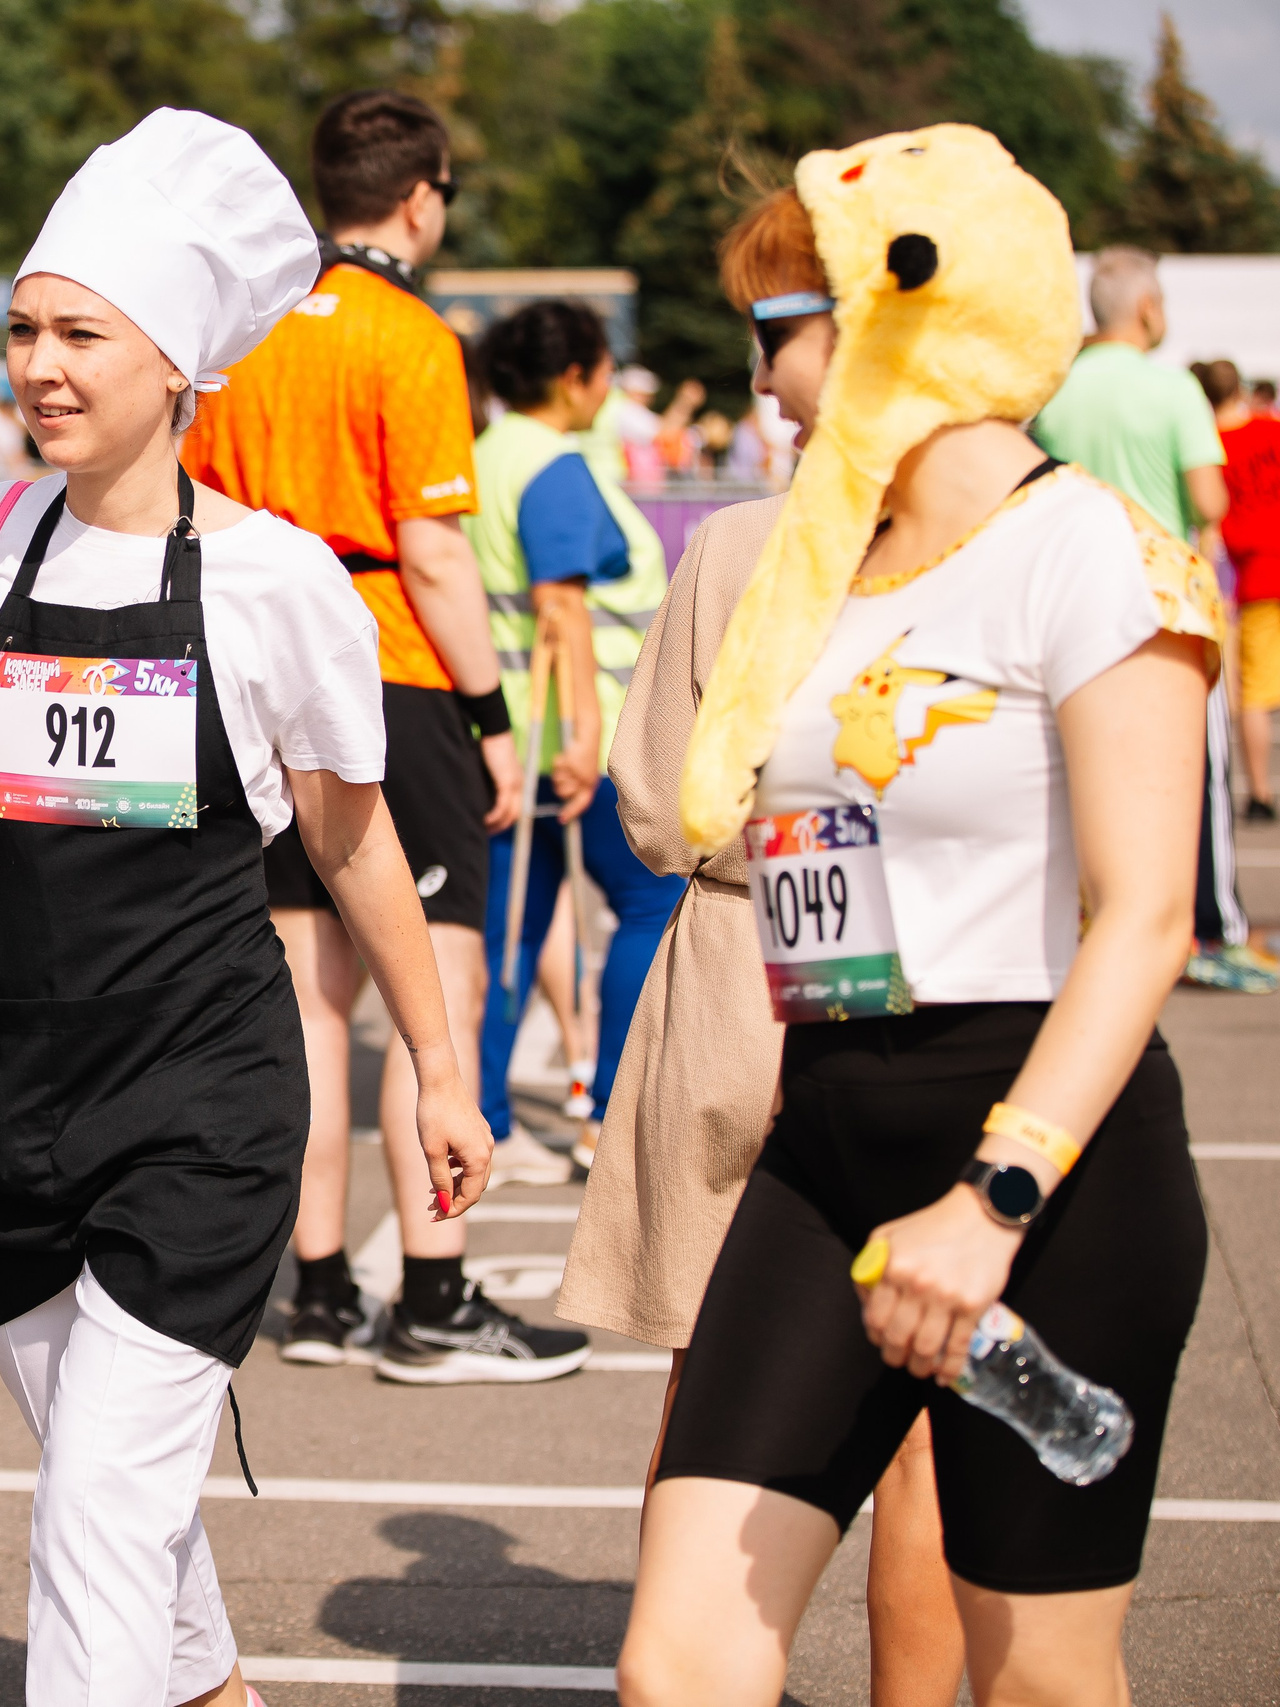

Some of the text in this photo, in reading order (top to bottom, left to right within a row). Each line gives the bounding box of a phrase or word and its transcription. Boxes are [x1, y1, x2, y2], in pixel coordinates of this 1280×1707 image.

[4, 659, 60, 677] КРАСОЧНЫЙ
[11, 674, 50, 692] ЗАБЕГ
[45, 703, 116, 768] 912
[760, 864, 848, 949] 4049
